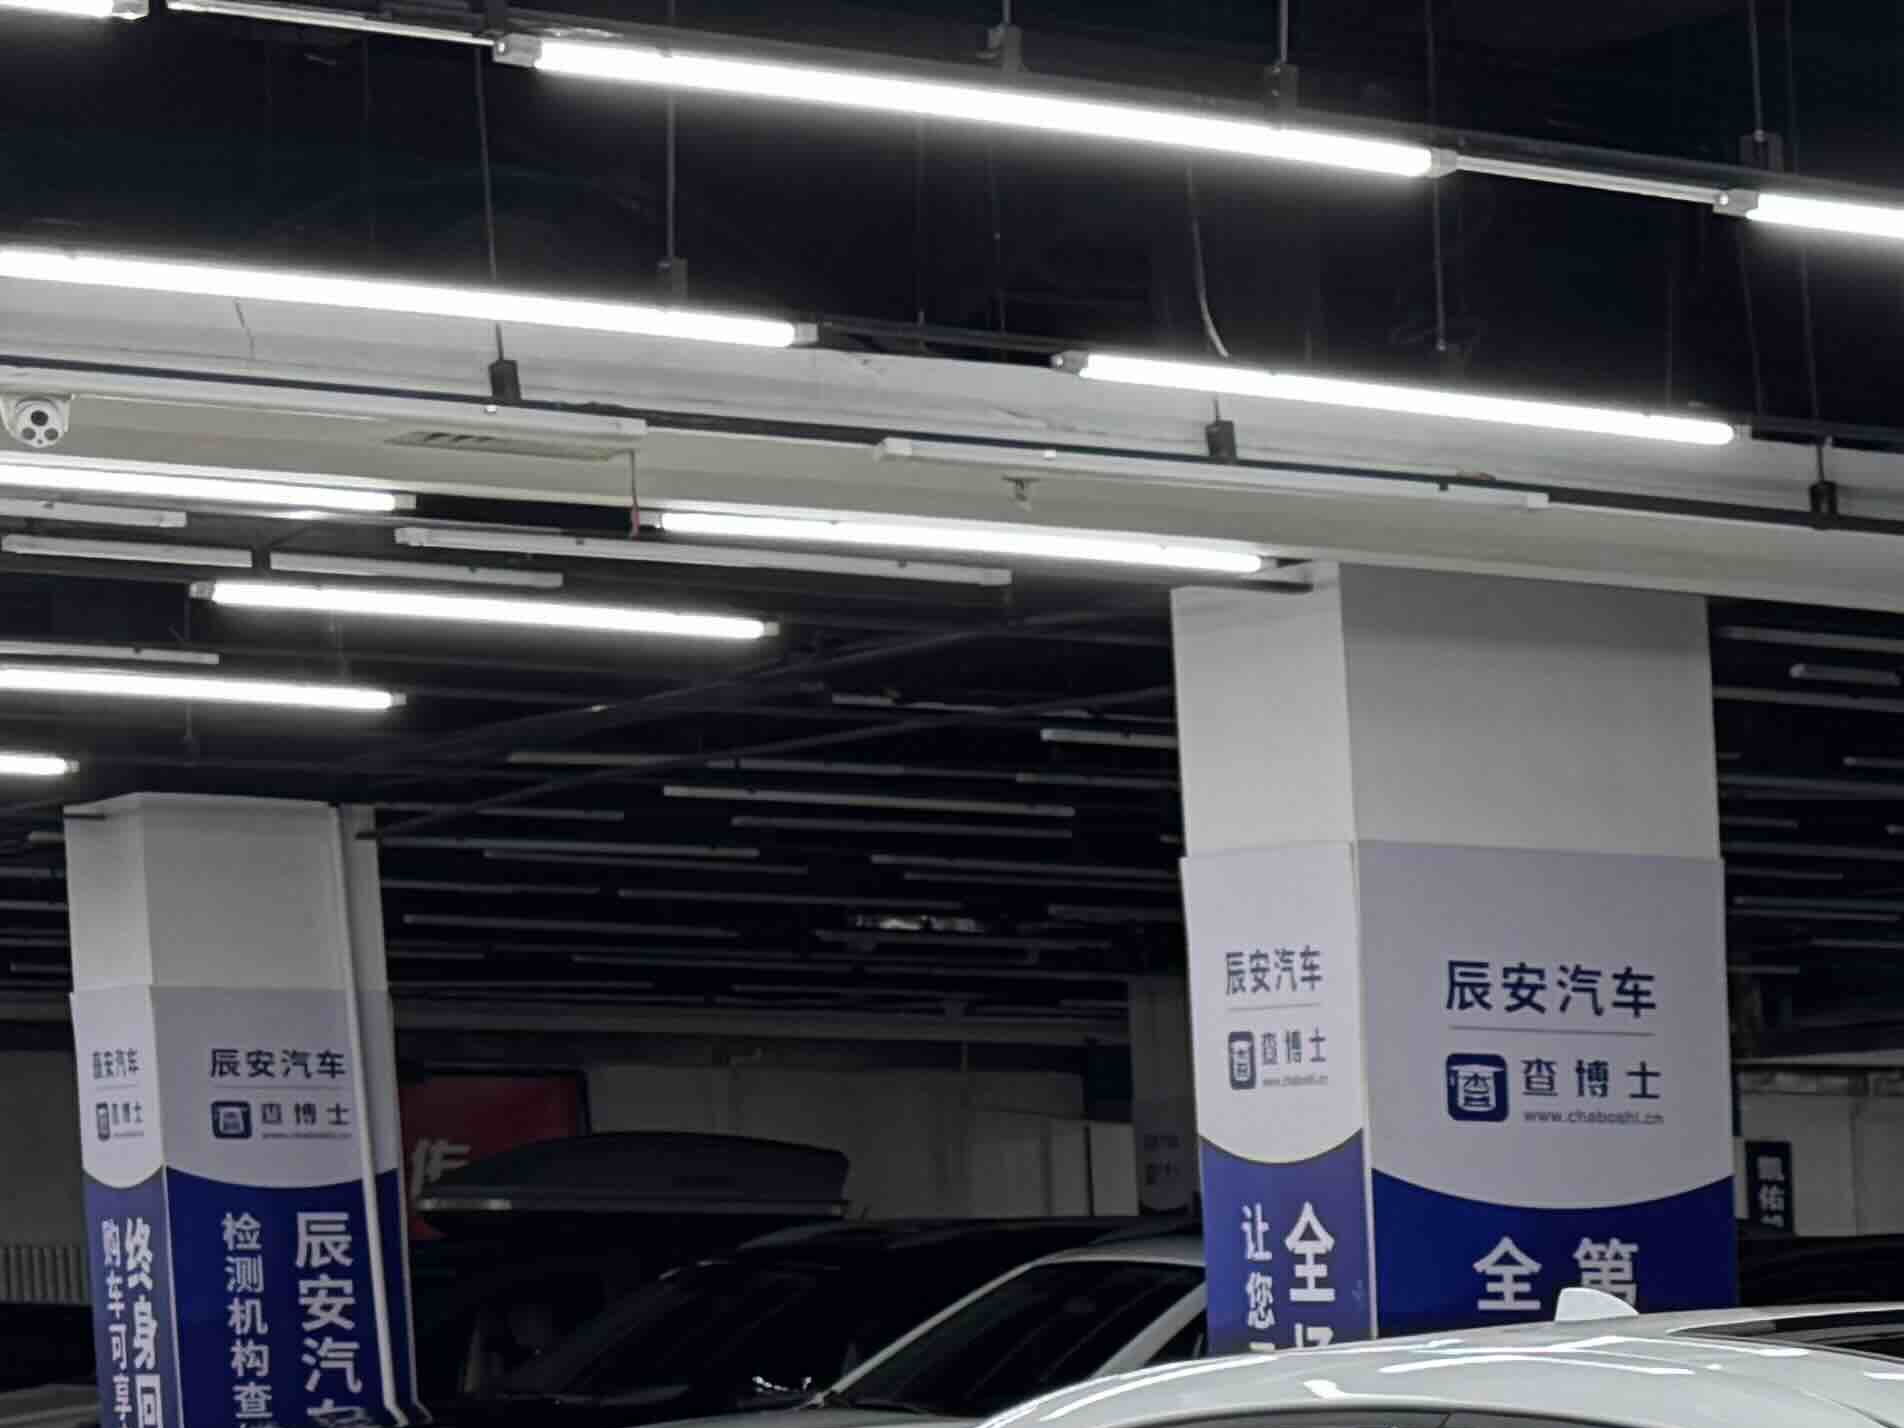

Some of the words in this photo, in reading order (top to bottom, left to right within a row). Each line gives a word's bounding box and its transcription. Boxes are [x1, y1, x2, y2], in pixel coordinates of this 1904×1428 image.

[1225, 944, 1323, 995] 辰安汽车
[1446, 960, 1656, 1018] 辰安汽车
[210, 1049, 346, 1080] 辰安汽车
[1520, 1058, 1662, 1099] 查博士
[1241, 1203, 1275, 1352] 让您
[1284, 1201, 1336, 1348] 全
[1472, 1236, 1543, 1311] 全
